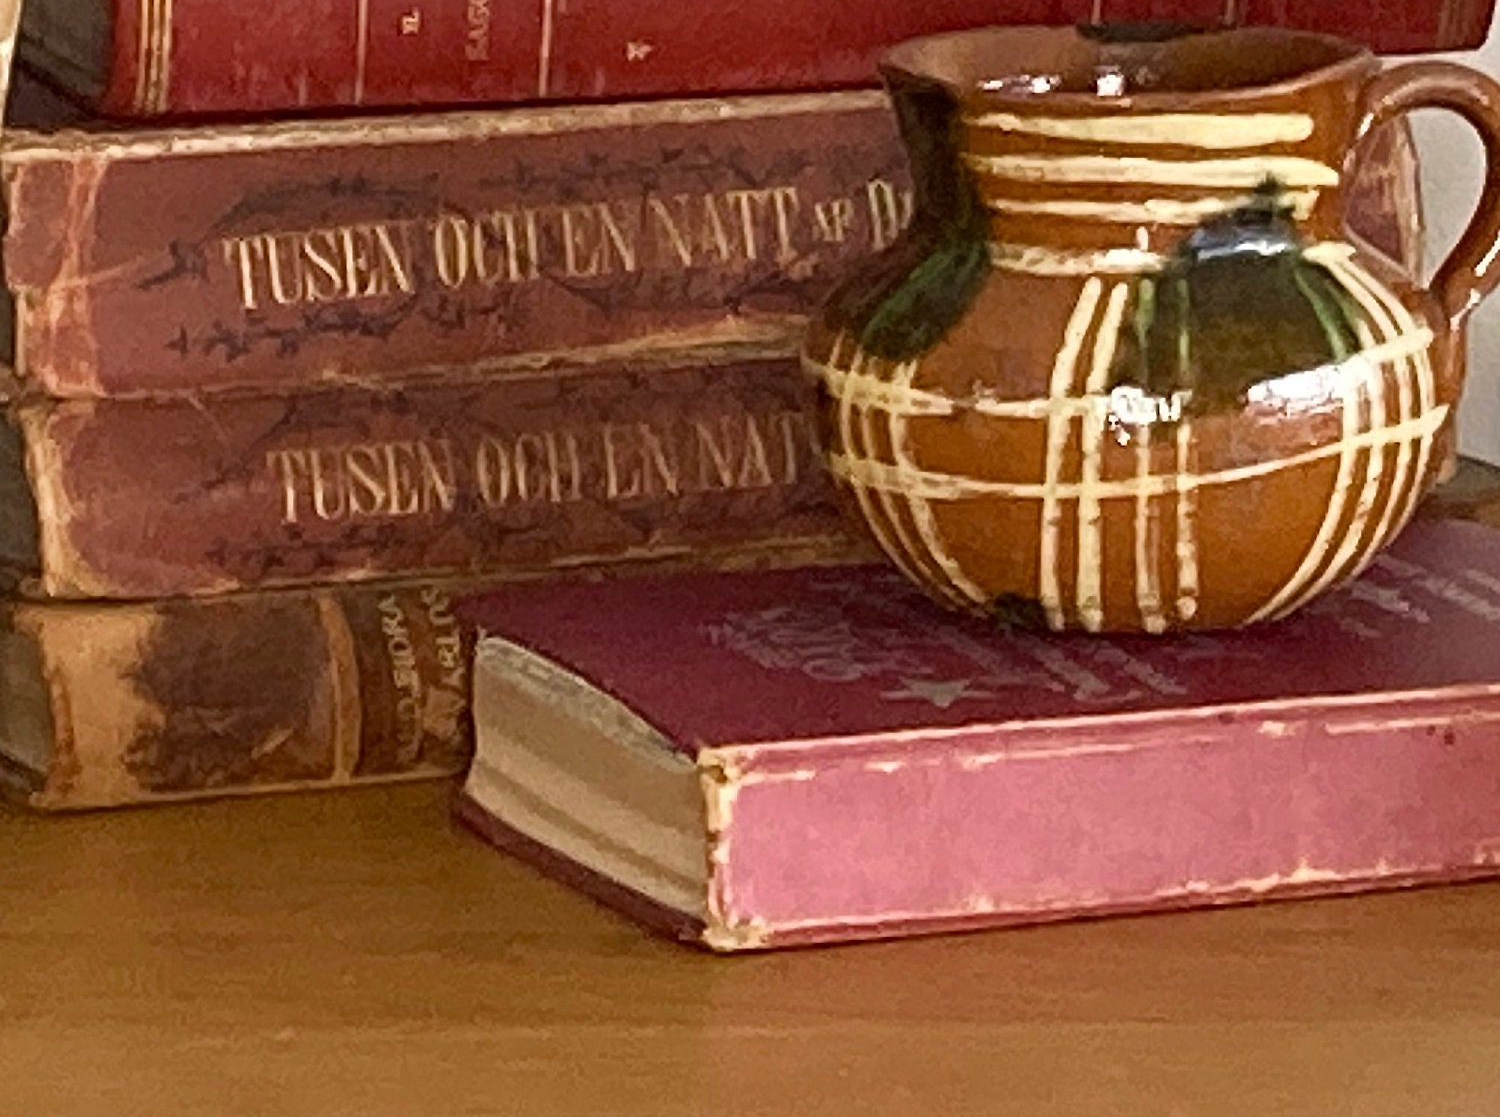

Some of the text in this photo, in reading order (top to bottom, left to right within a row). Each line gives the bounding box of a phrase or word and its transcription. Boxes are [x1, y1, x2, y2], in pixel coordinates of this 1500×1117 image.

[221, 219, 415, 311] TUSEN
[431, 212, 538, 288] OCH
[554, 199, 637, 278] EN
[650, 186, 797, 270] NATT
[266, 437, 456, 525] TUSEN
[476, 429, 583, 508] OCH
[600, 423, 680, 499] EN
